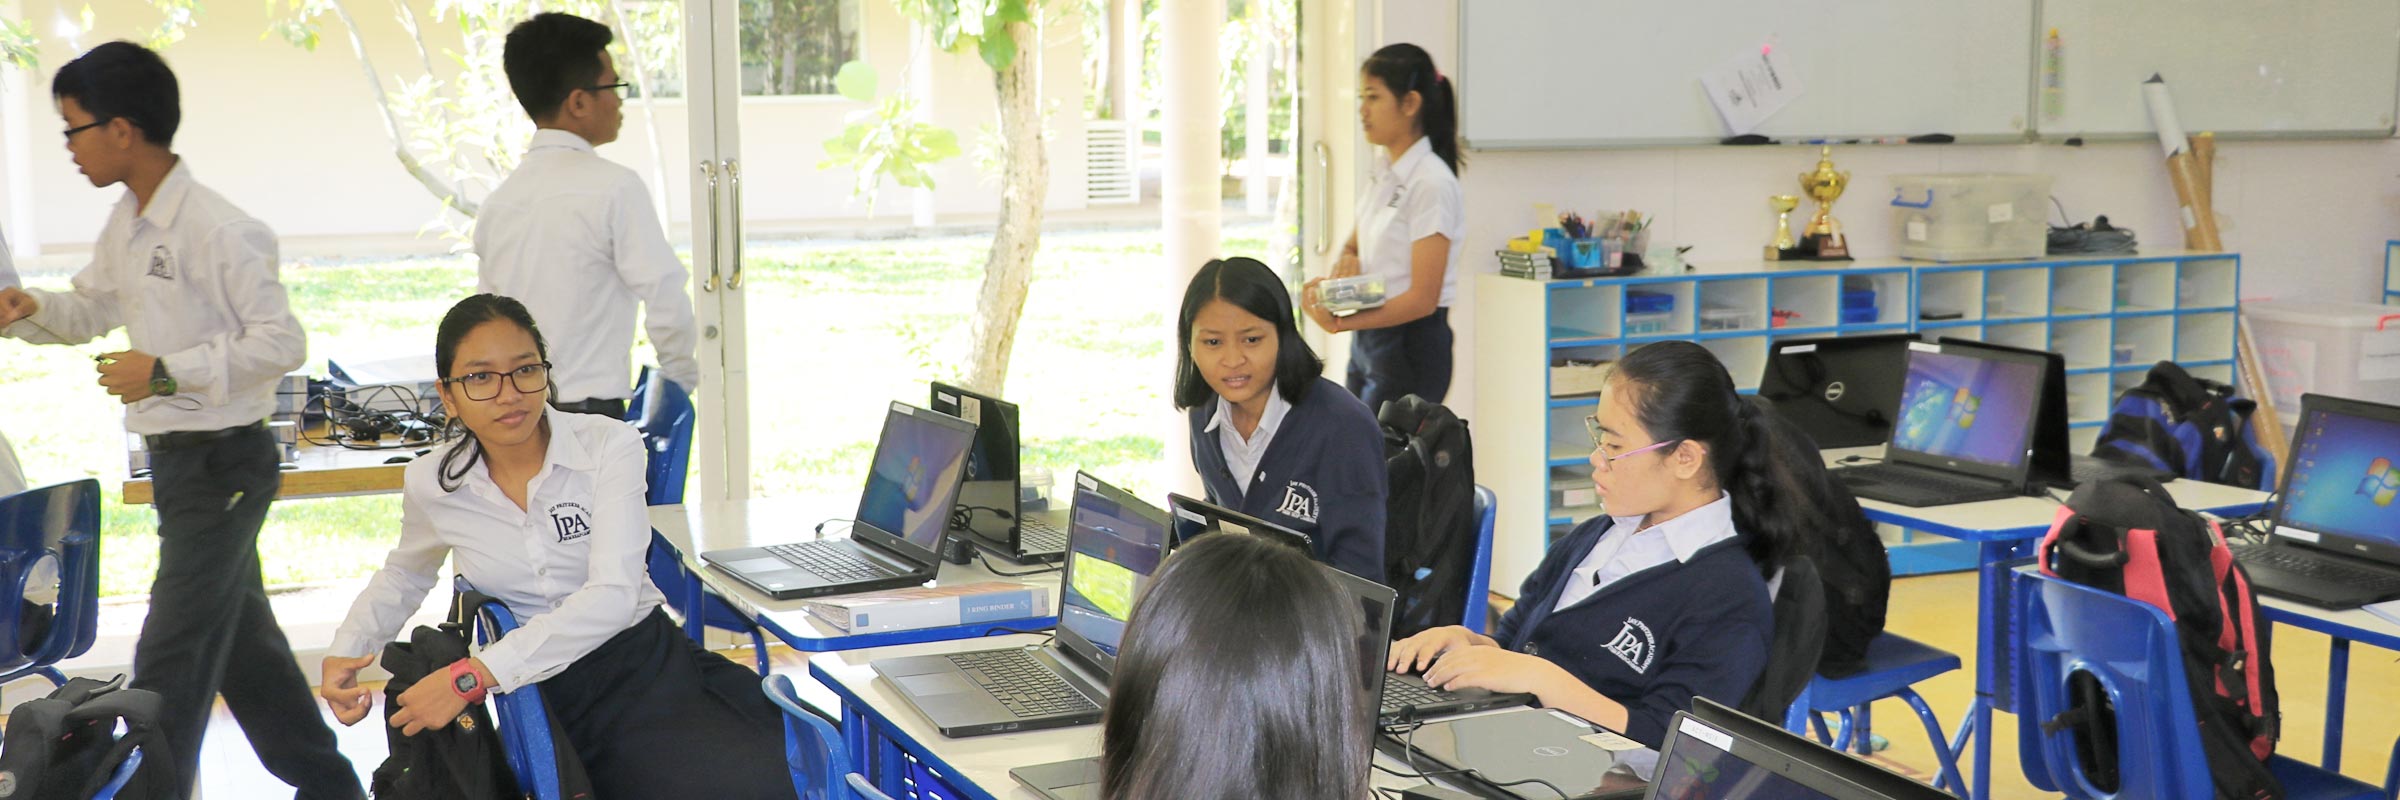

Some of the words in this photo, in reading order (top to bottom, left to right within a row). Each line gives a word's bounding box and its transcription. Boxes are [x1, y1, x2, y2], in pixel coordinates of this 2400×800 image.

[1275, 485, 1311, 517] JPA
[550, 513, 590, 543] JPA
[971, 605, 989, 613] RING
[989, 603, 1015, 612] BINDER
[1600, 620, 1643, 665] JPA
